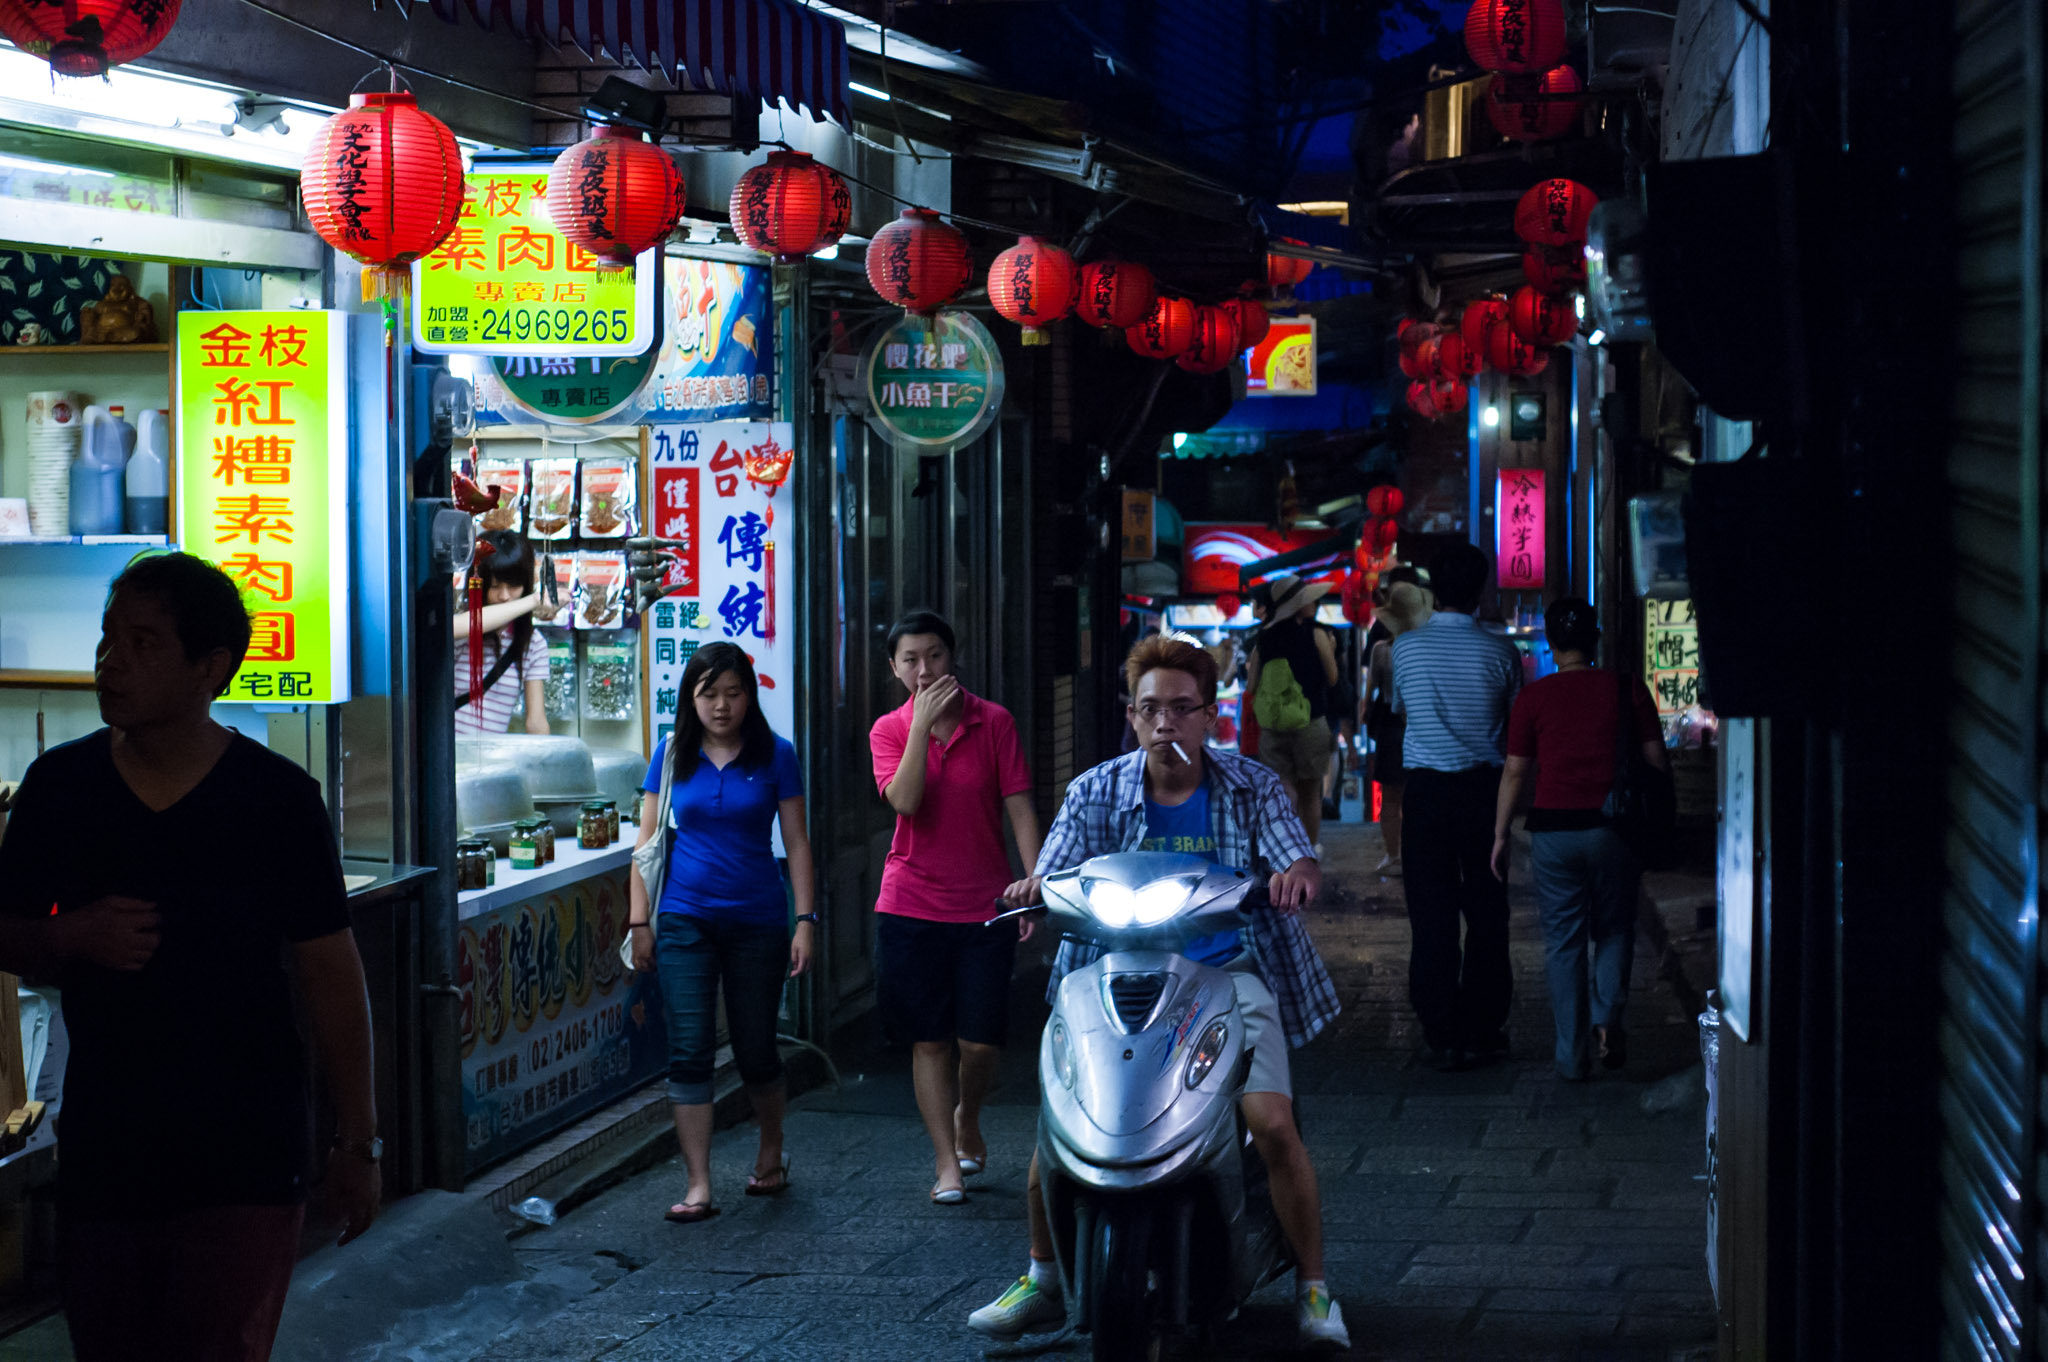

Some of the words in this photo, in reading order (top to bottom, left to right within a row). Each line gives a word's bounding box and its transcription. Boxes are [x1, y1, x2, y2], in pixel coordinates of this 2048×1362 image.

[336, 133, 373, 227] 文化學會
[578, 150, 614, 239] 越夜越美
[473, 281, 587, 302] 專賣店
[427, 306, 469, 322] 加盟
[200, 322, 308, 367] 金枝
[427, 326, 469, 342] 直營
[541, 387, 609, 408] 專賣店
[881, 382, 957, 409] 小魚干
[654, 429, 699, 462] 九份
[212, 376, 296, 662] 紅糟素肉圓
[717, 511, 768, 639] 傳統
[222, 671, 312, 698] 宅配
